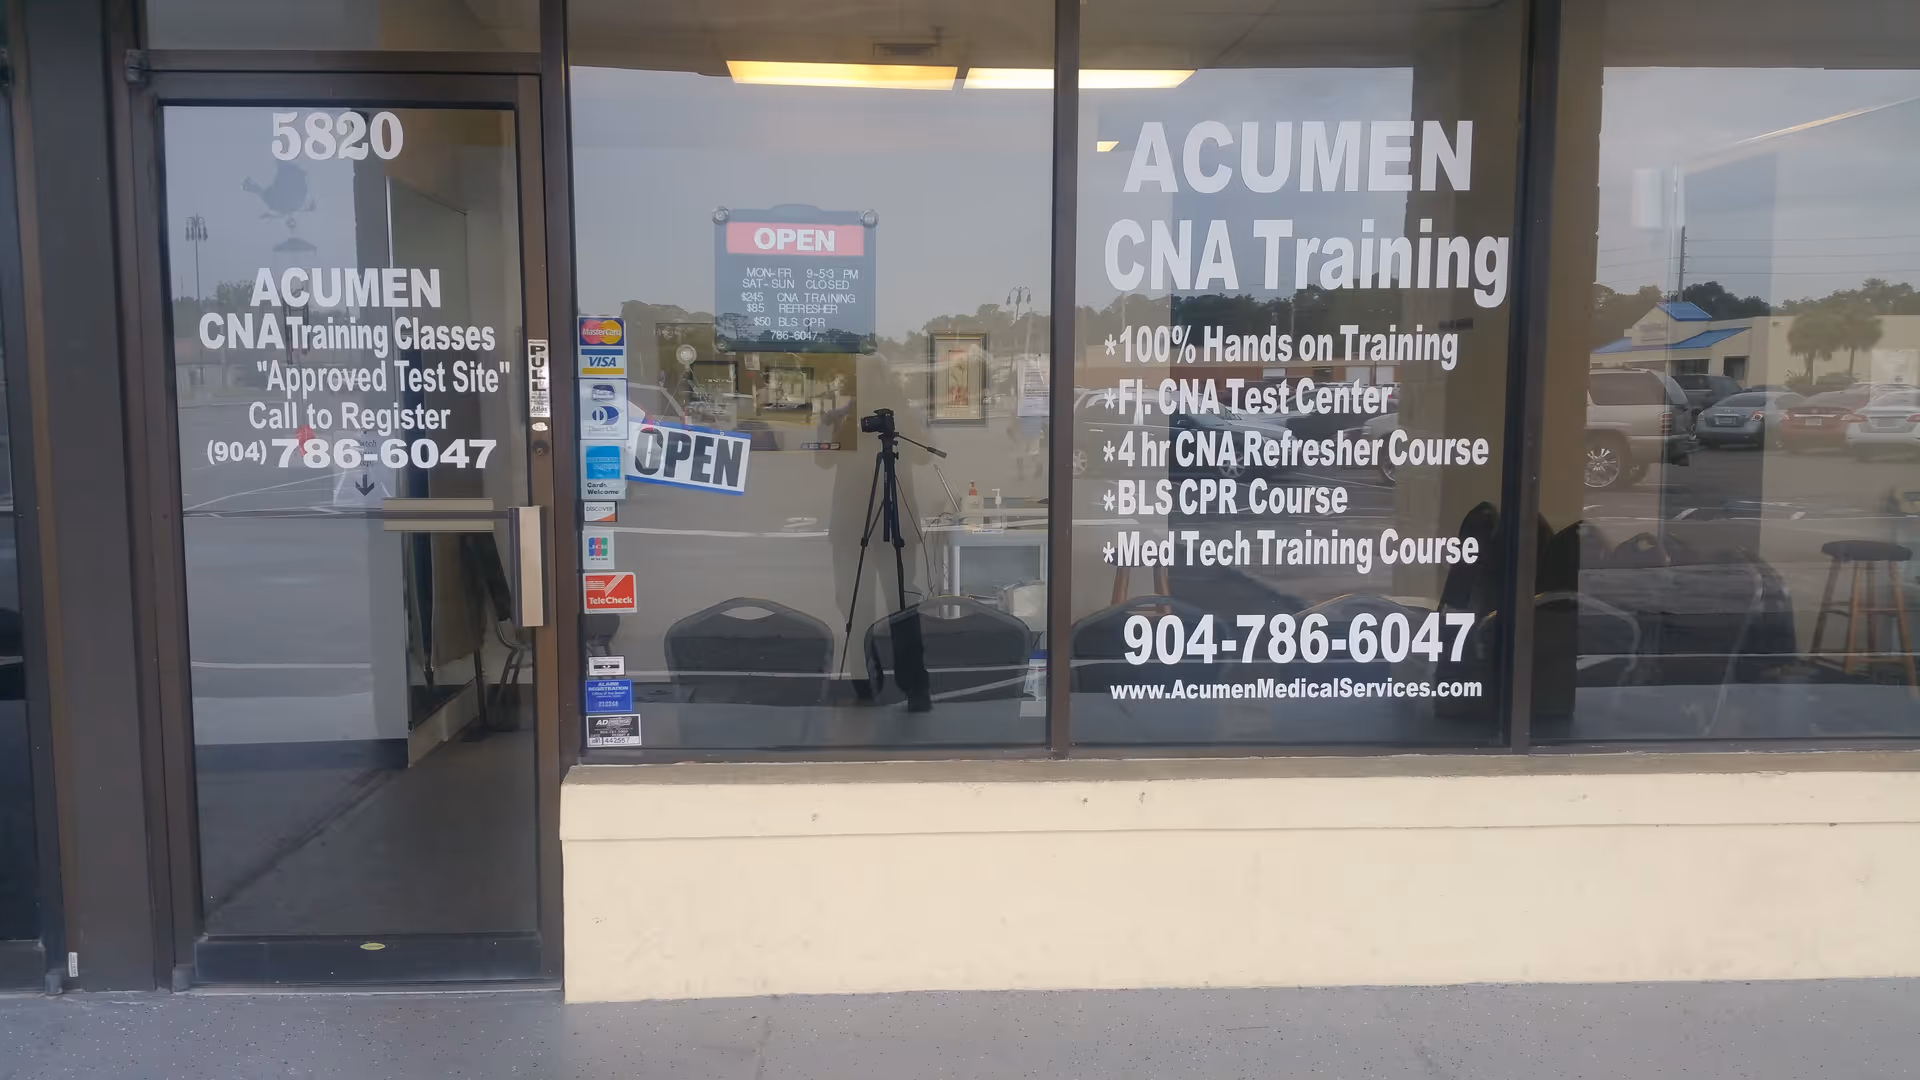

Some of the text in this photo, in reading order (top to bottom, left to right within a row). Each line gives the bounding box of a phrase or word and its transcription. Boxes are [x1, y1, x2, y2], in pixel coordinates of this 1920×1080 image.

[272, 111, 403, 160] 5820
[1123, 120, 1474, 194] ACUMEN
[754, 227, 835, 251] OPEN
[843, 269, 859, 280] PM
[1104, 219, 1510, 308] CNA Training
[250, 267, 441, 308] ACUMEN
[741, 292, 856, 304] $245 CNA TRAINING
[805, 279, 850, 290] CLOSED
[746, 303, 838, 314] $85 REFRESHER
[753, 316, 826, 328] $50 BLS CPR
[199, 313, 496, 358] CNA Training Classes
[582, 328, 621, 336] MasterCard
[770, 330, 818, 341] 786-6047
[1204, 325, 1293, 362] Hands
[1299, 334, 1333, 362] on
[1339, 324, 1459, 371] Training
[256, 360, 510, 399] "Approved Test Site"
[530, 345, 547, 391] PULL
[588, 356, 617, 367] VISA
[1158, 378, 1220, 415] CNA
[1226, 378, 1289, 415] Test
[1295, 377, 1393, 414] Center
[249, 401, 451, 436] Call to Register
[207, 438, 497, 469] (904) 786-6047
[634, 427, 743, 487] OPEN
[1141, 431, 1171, 467] hr
[1175, 430, 1237, 467] CNA
[1244, 430, 1383, 467] Refresher
[1388, 429, 1489, 467] Course
[1179, 478, 1237, 515] CPR
[1248, 477, 1349, 514] Course
[1181, 529, 1250, 566] Tech
[1257, 529, 1373, 574] Training
[1379, 528, 1480, 565] Course
[589, 597, 633, 605] TeleCheck
[1123, 612, 1476, 666] 904-786-6047
[1110, 677, 1482, 699] www.AcumenMedicalServices.com
